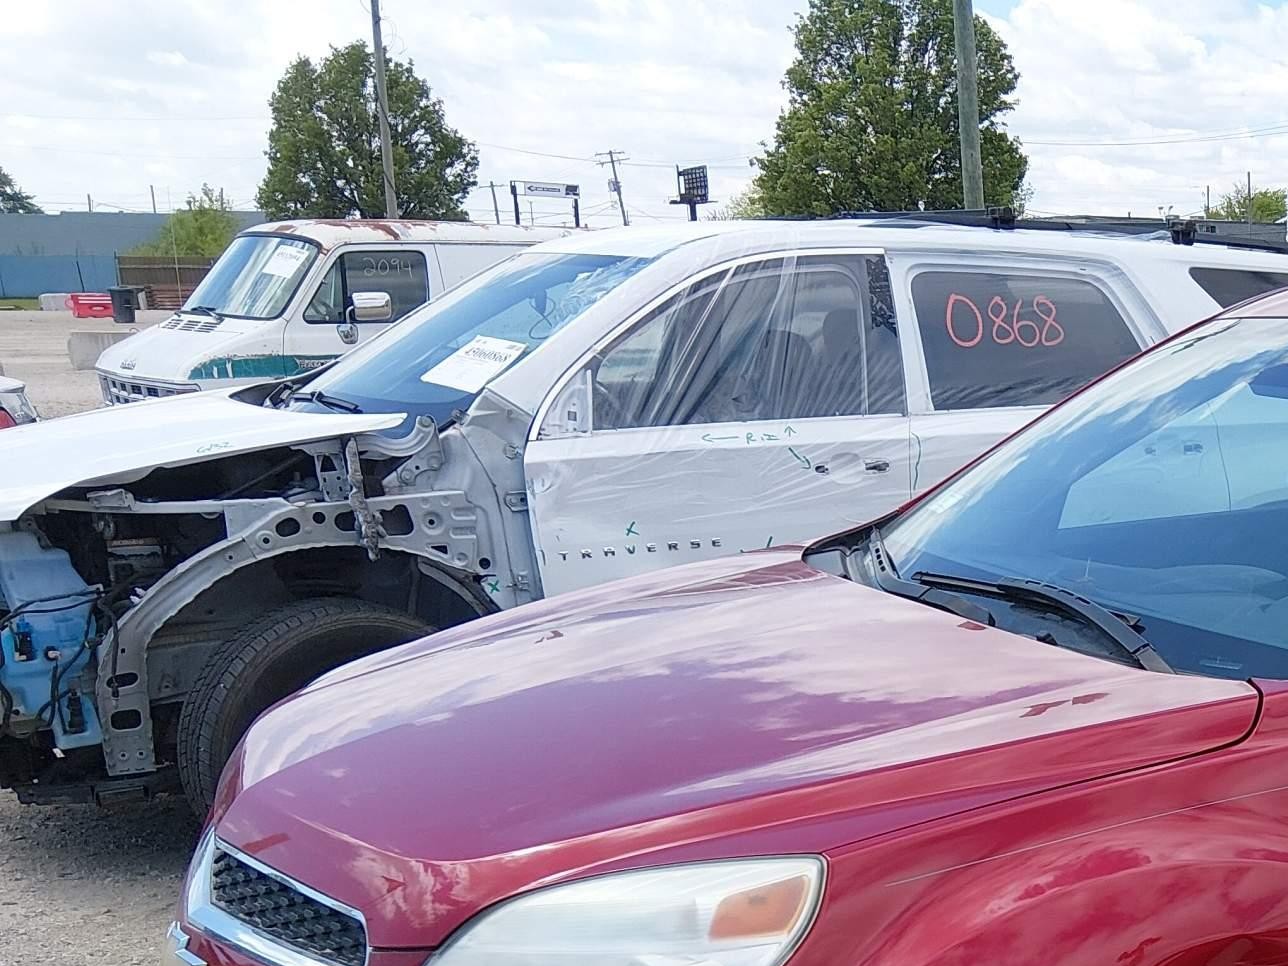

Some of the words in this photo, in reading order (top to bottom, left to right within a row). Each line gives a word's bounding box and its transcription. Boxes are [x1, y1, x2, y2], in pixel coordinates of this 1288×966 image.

[362, 256, 413, 279] 2094
[945, 293, 1065, 348] 0868
[558, 537, 722, 562] TRAVERSE
